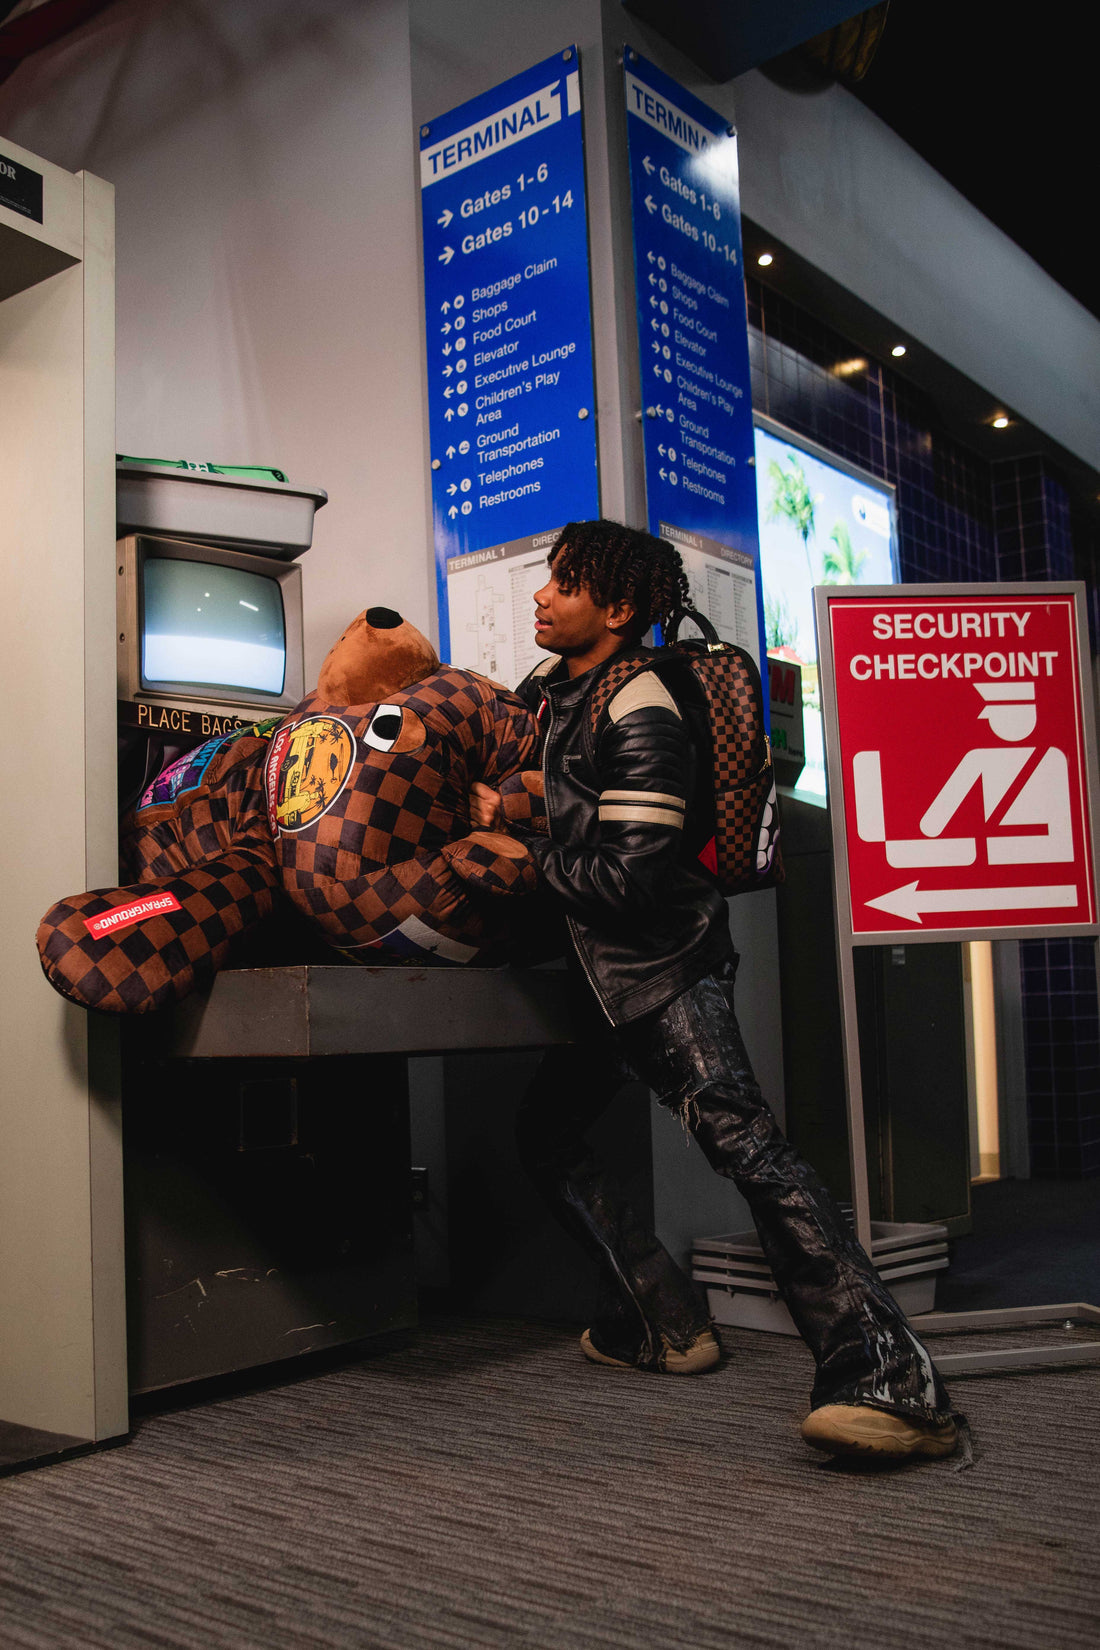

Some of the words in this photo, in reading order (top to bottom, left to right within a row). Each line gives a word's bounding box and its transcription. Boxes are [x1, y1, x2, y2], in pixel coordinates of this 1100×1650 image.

[428, 100, 550, 175] TERMINAL
[550, 76, 569, 120] 1
[460, 184, 511, 219] Gates
[660, 166, 697, 206] Gates
[461, 220, 513, 255] Gates
[661, 203, 699, 242] Gates
[471, 271, 522, 302] Baggage
[524, 256, 558, 280] Claim
[671, 263, 706, 296] Baggage
[707, 285, 729, 309] Claim
[472, 300, 508, 324] Shops
[671, 285, 698, 312] Shops
[473, 325, 502, 345] Food
[505, 309, 537, 333] Court
[673, 307, 695, 330] Food
[696, 320, 717, 343] Court
[474, 340, 520, 367] Elevator
[674, 329, 707, 357] Elevator
[475, 357, 529, 388] Executive
[532, 341, 576, 368] Lounge
[675, 351, 714, 382] Executive
[715, 372, 743, 400] Lounge
[475, 380, 532, 410] Children's
[535, 371, 561, 392] Play
[676, 374, 717, 406] Children's
[717, 395, 734, 417] Play
[678, 391, 697, 412] Area
[476, 409, 502, 427] Area
[679, 413, 709, 439] Ground
[477, 423, 519, 448] Ground
[477, 427, 560, 465] Transportation
[680, 430, 736, 467] Transportation
[478, 456, 544, 487] Telephones
[681, 452, 727, 485] Telephones
[479, 481, 541, 509] Restrooms
[682, 475, 725, 506] Restrooms
[532, 530, 563, 548] DIREC
[660, 523, 698, 547] TERMINAL
[449, 549, 498, 572] TERMINAL
[500, 547, 506, 557] 1
[872, 611, 1032, 640] SECURITY
[849, 651, 1059, 681] CHECKPOINT
[138, 704, 192, 733] PLACE
[201, 714, 242, 736] BAGS
[273, 732, 287, 754] LOS
